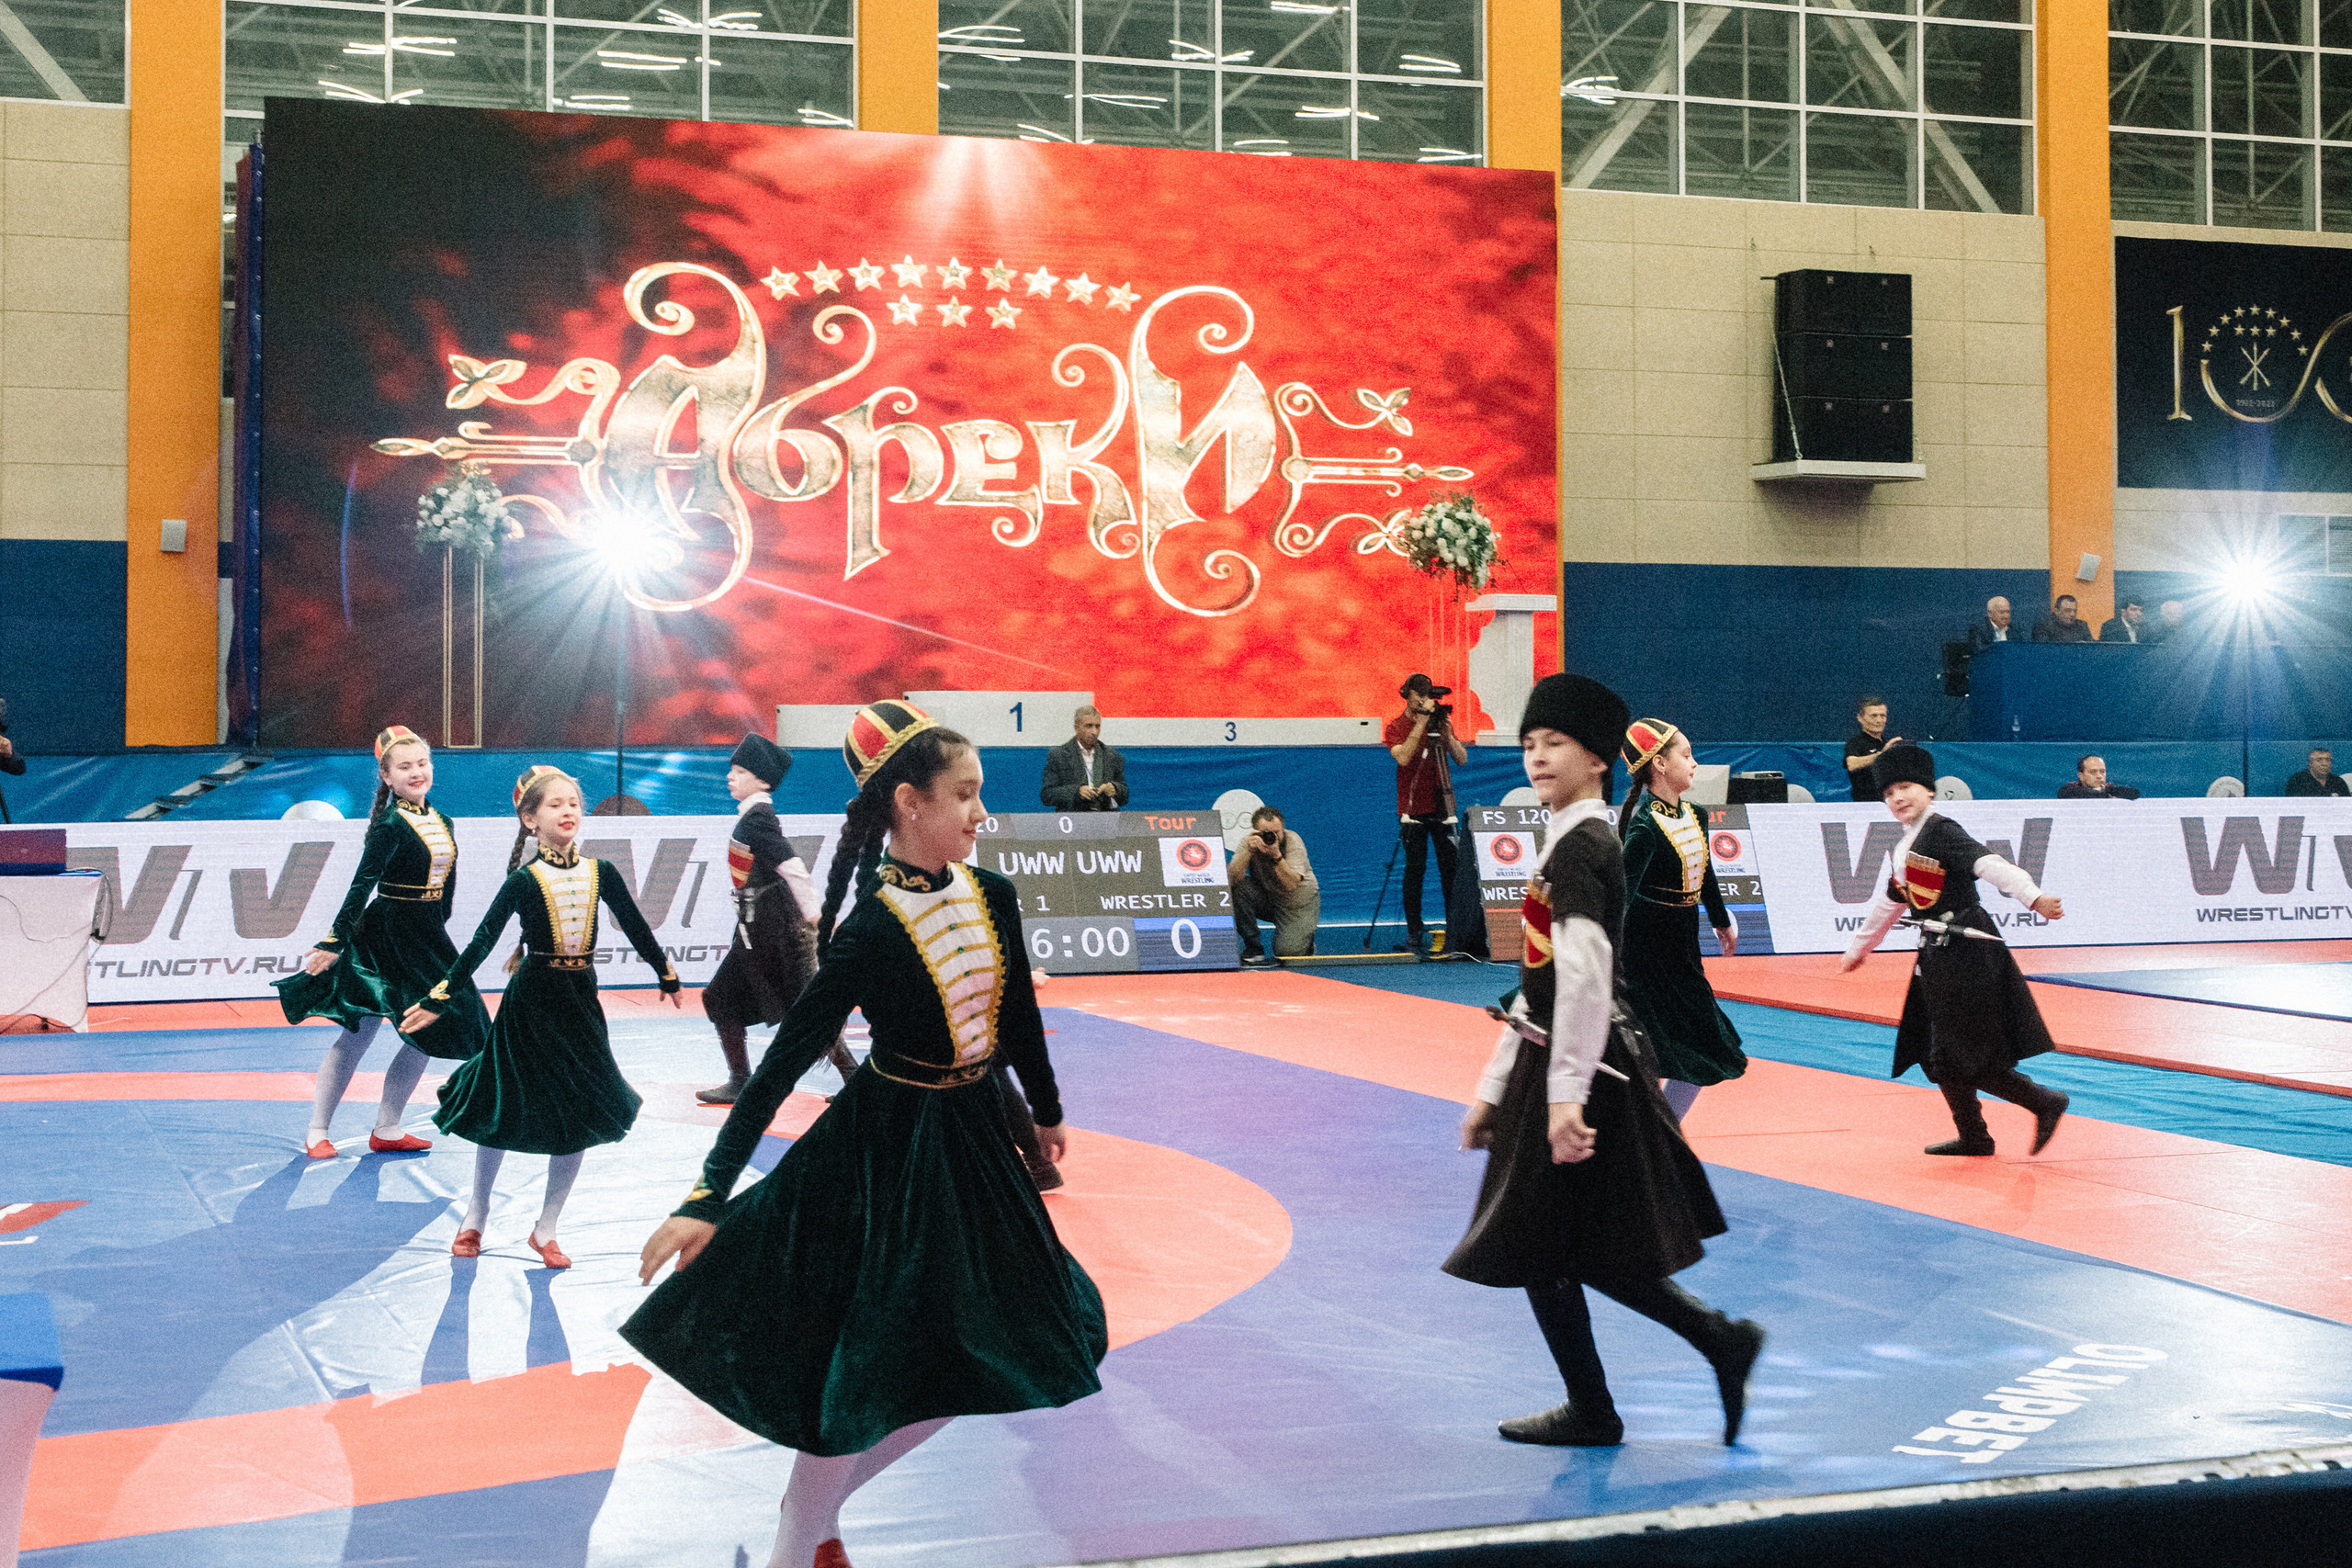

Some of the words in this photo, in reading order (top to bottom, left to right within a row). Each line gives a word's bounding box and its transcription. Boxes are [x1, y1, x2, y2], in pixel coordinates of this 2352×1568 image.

[1010, 703, 1023, 732] 1
[1224, 721, 1237, 742] 3
[1058, 816, 1073, 833] 0
[1145, 816, 1196, 829] Tour
[1482, 810, 1506, 825] FS
[1517, 809, 1552, 825] 120
[998, 851, 1065, 875] UWW
[1077, 850, 1142, 874] UWW
[1482, 886, 1529, 900] WRES
[1749, 881, 1762, 896] 2
[1036, 895, 1050, 911] 1
[1101, 894, 1207, 910] WRESTLER
[1219, 891, 1231, 908] 2
[2197, 905, 2352, 922] WRESTLINGT
[1031, 926, 1130, 959] 6:00
[1170, 919, 1202, 958] 0
[93, 955, 306, 979] TLINGTV.RU
[1891, 1343, 2170, 1464] OLIMPBET
